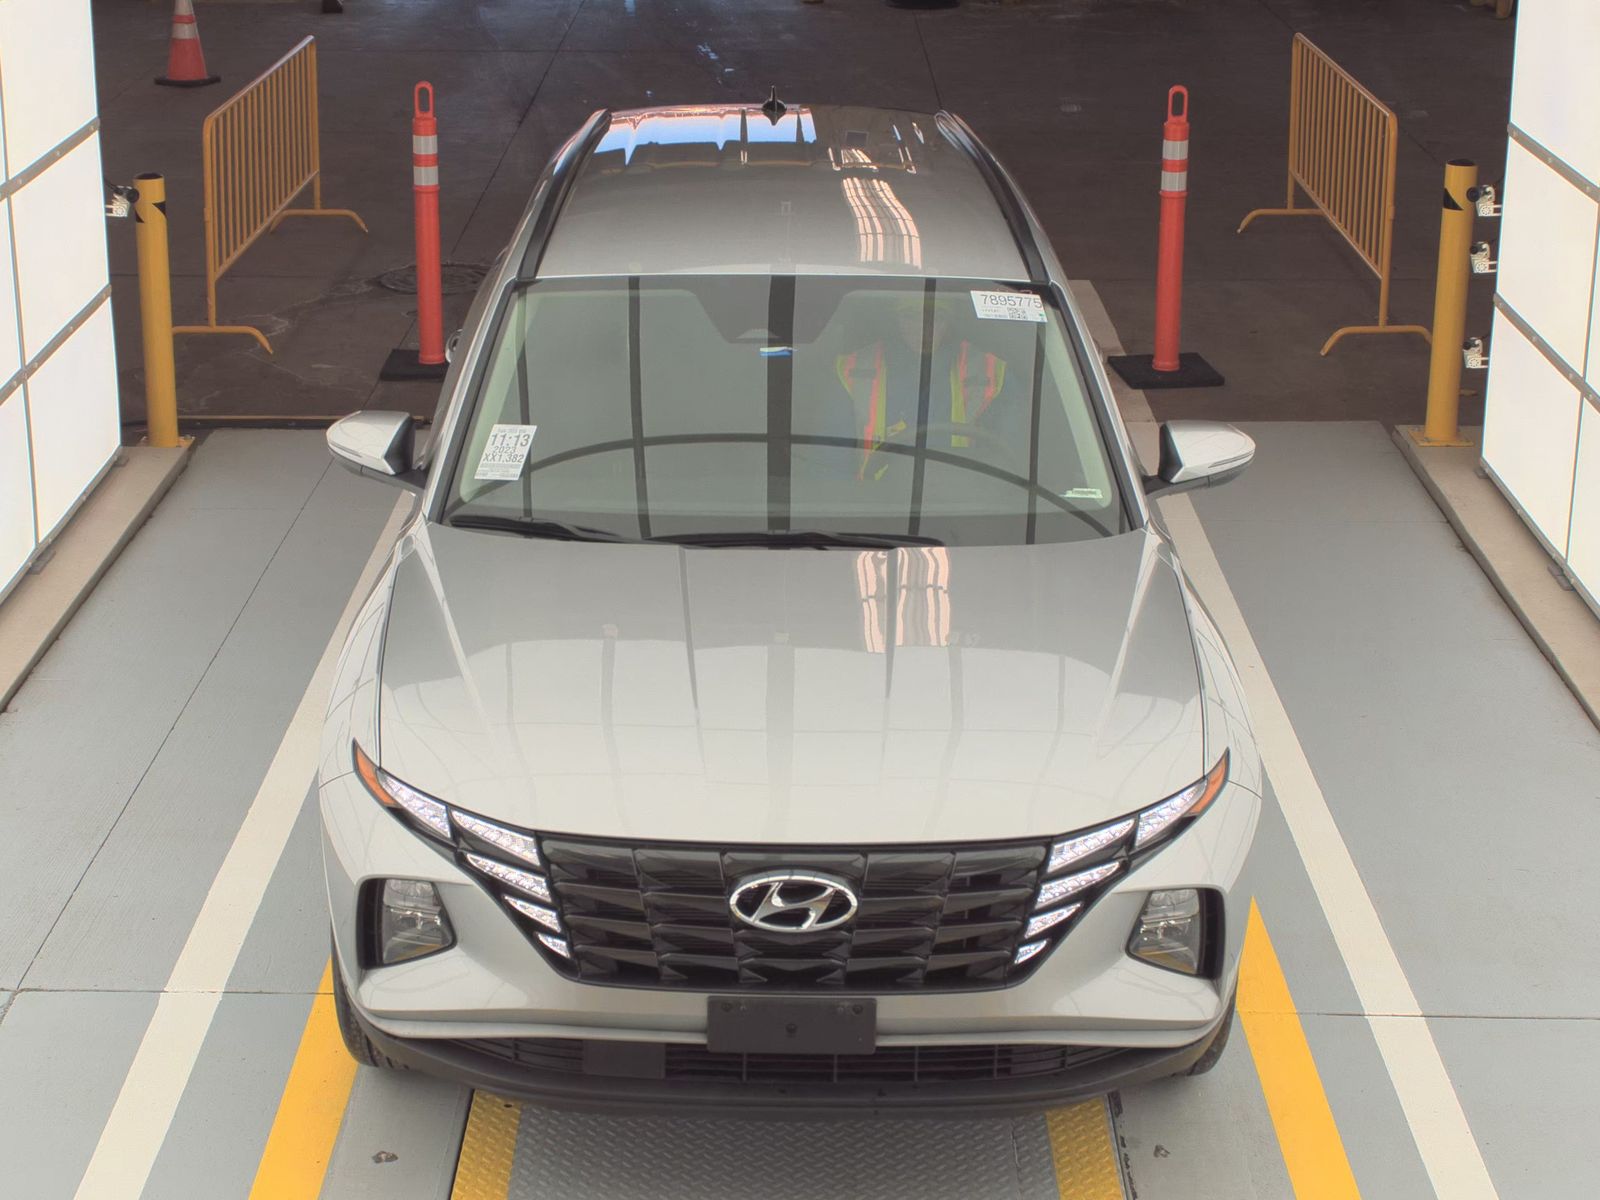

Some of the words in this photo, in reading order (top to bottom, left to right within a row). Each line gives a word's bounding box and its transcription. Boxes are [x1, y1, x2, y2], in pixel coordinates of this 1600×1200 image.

[981, 294, 1043, 308] 7895775
[491, 433, 530, 447] 11:13
[493, 446, 517, 454] 2023
